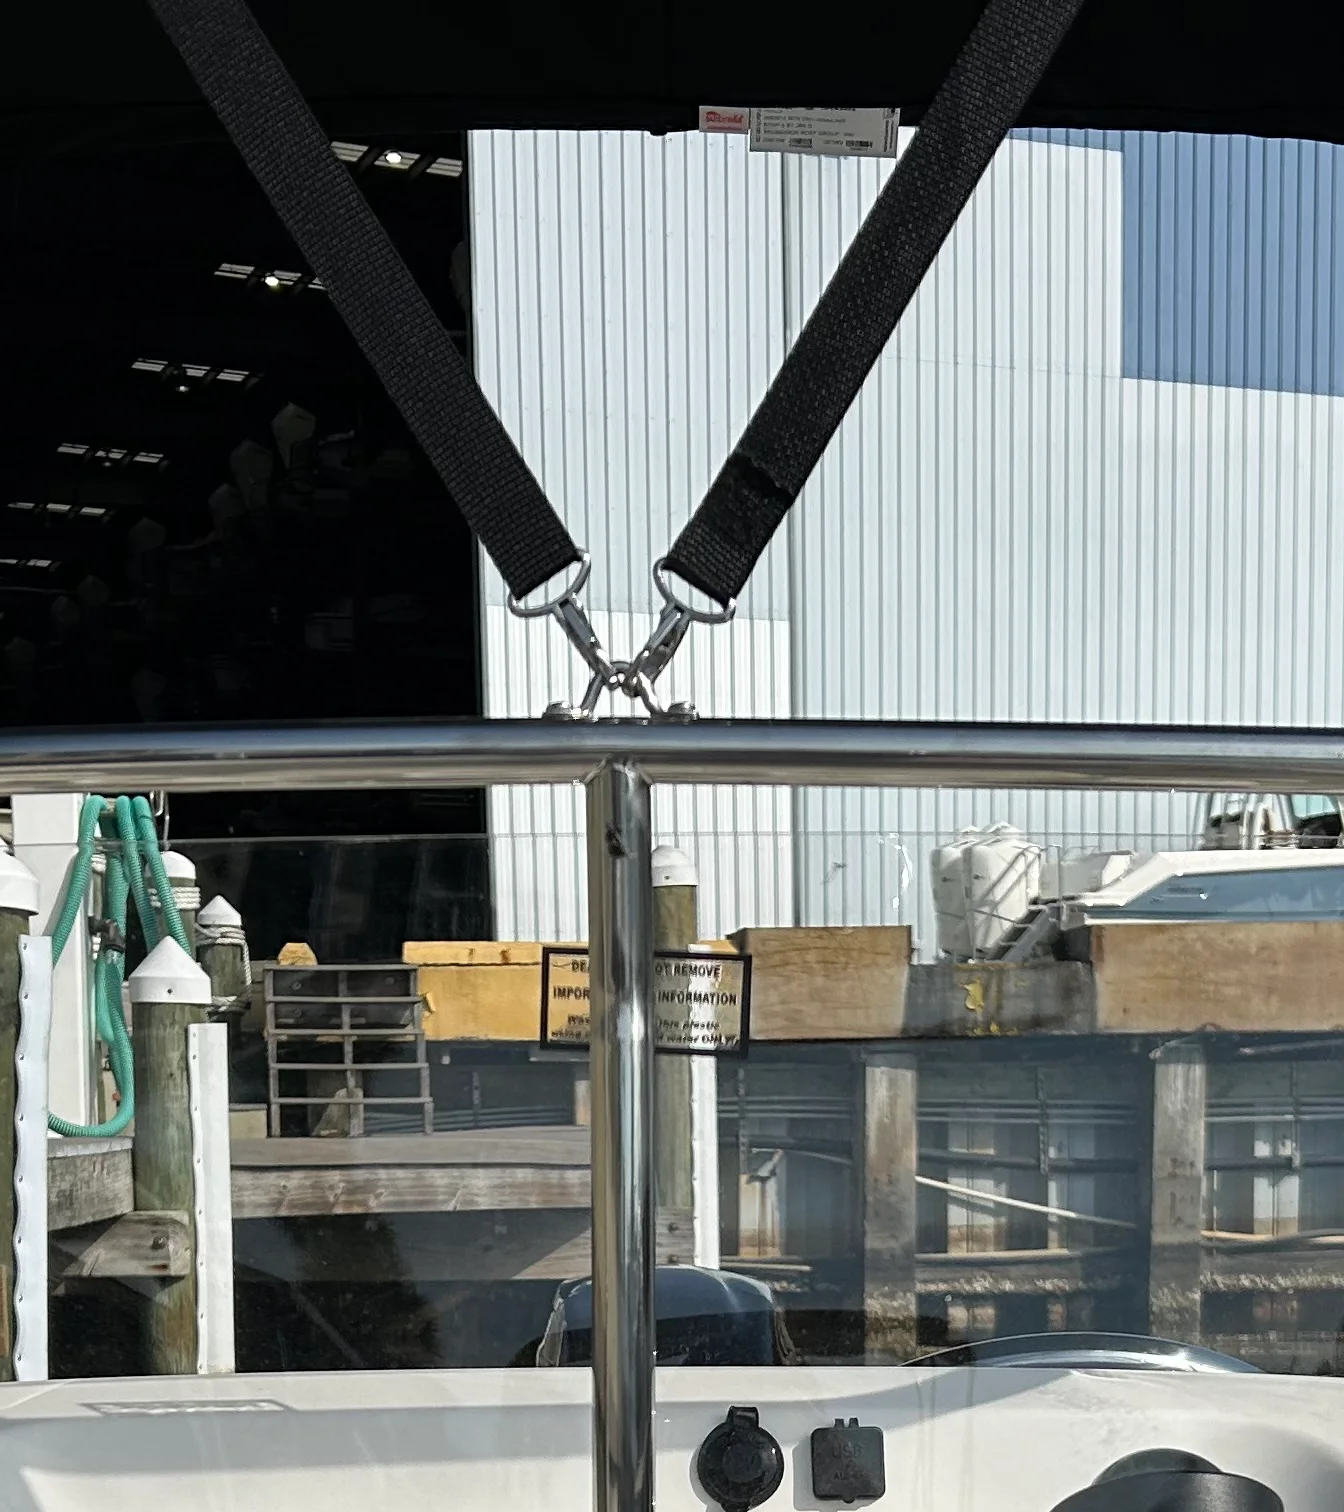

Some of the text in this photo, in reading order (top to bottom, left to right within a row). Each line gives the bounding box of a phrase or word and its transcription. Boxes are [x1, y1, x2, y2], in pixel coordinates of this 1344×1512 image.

[673, 962, 722, 979] REMOVE
[553, 985, 738, 1007] IMPOR INFORMATION
